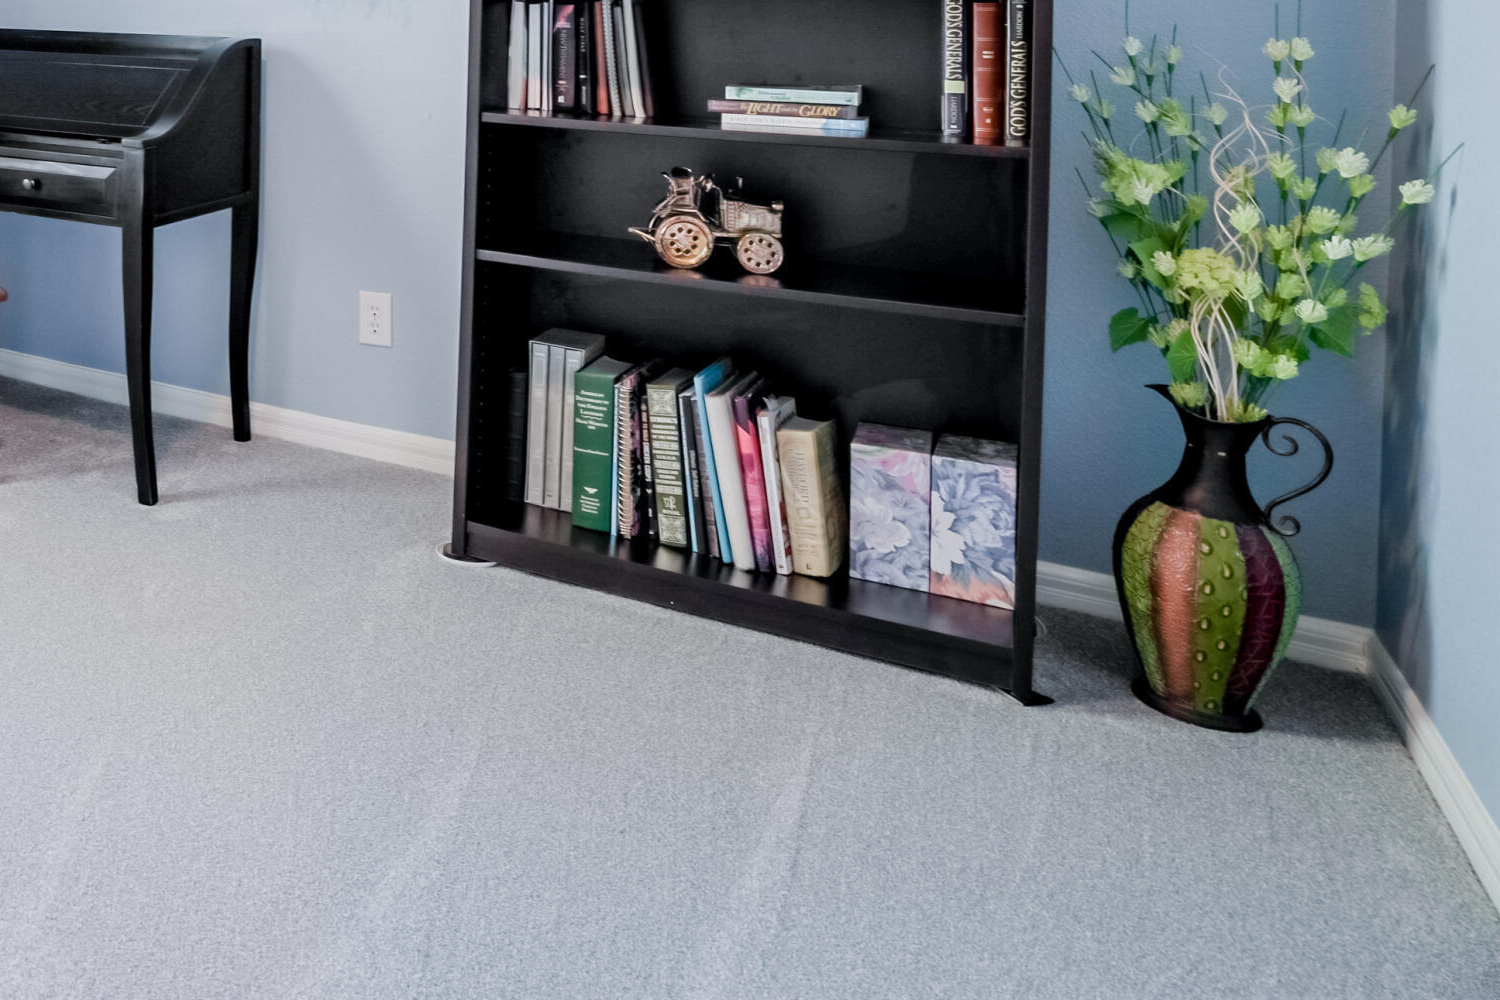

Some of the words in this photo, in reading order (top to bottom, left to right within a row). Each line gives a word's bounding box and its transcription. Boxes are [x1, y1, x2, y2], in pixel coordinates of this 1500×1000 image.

[1015, 10, 1024, 39] LIARDON
[946, 28, 963, 80] GENERALS
[1010, 40, 1027, 99] GENERALS
[747, 101, 784, 115] LIGHT
[799, 104, 842, 117] GLORY
[1010, 100, 1027, 136] GOD'S
[643, 442, 651, 465] CHICKEN
[644, 465, 652, 482] COOPS
